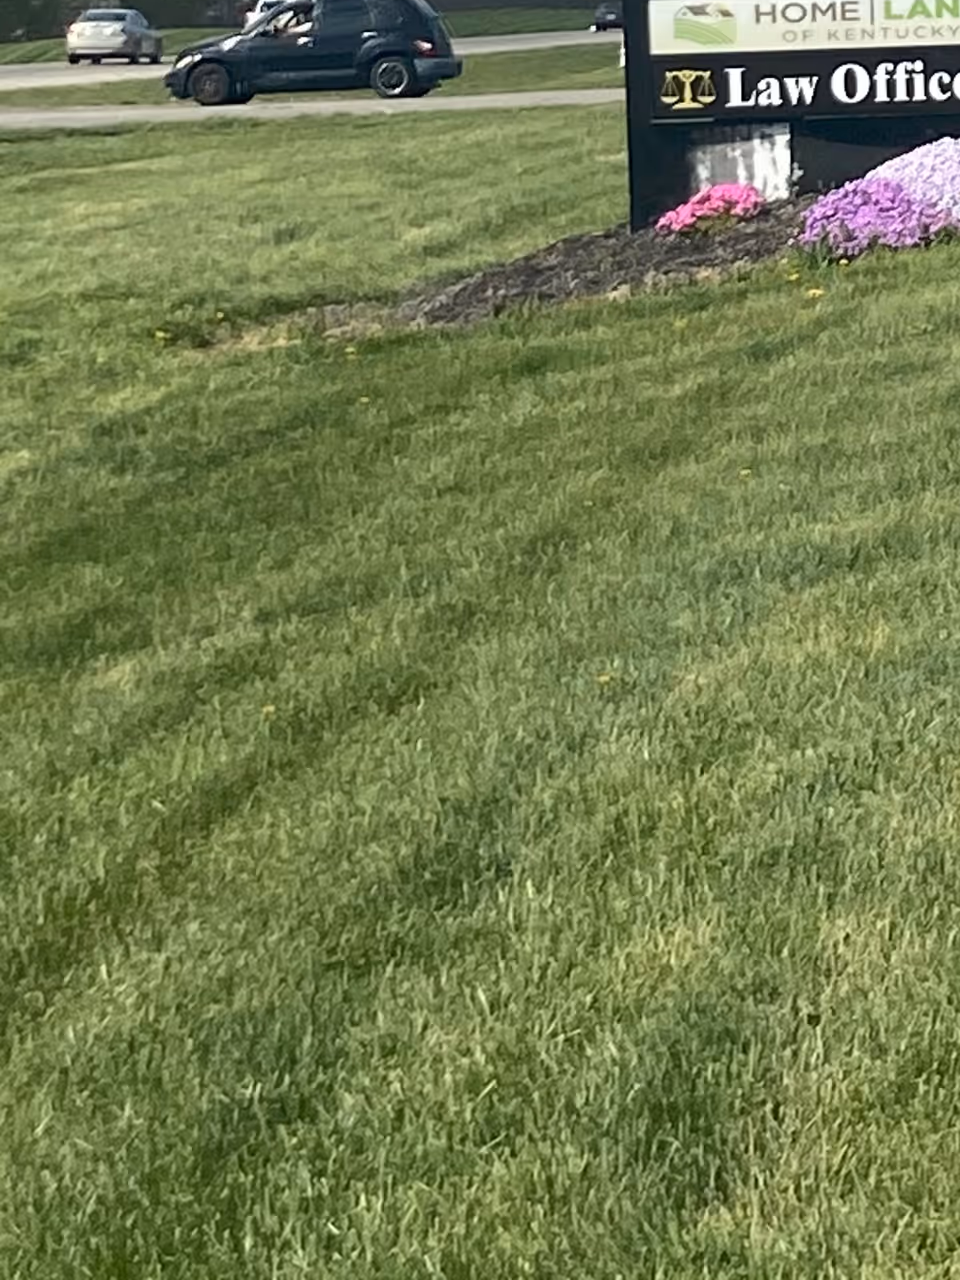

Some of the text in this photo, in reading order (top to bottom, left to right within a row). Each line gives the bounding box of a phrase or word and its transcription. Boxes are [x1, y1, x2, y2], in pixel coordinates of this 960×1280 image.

[753, 0, 861, 25] HOME
[781, 28, 811, 43] OF
[724, 66, 819, 108] Law
